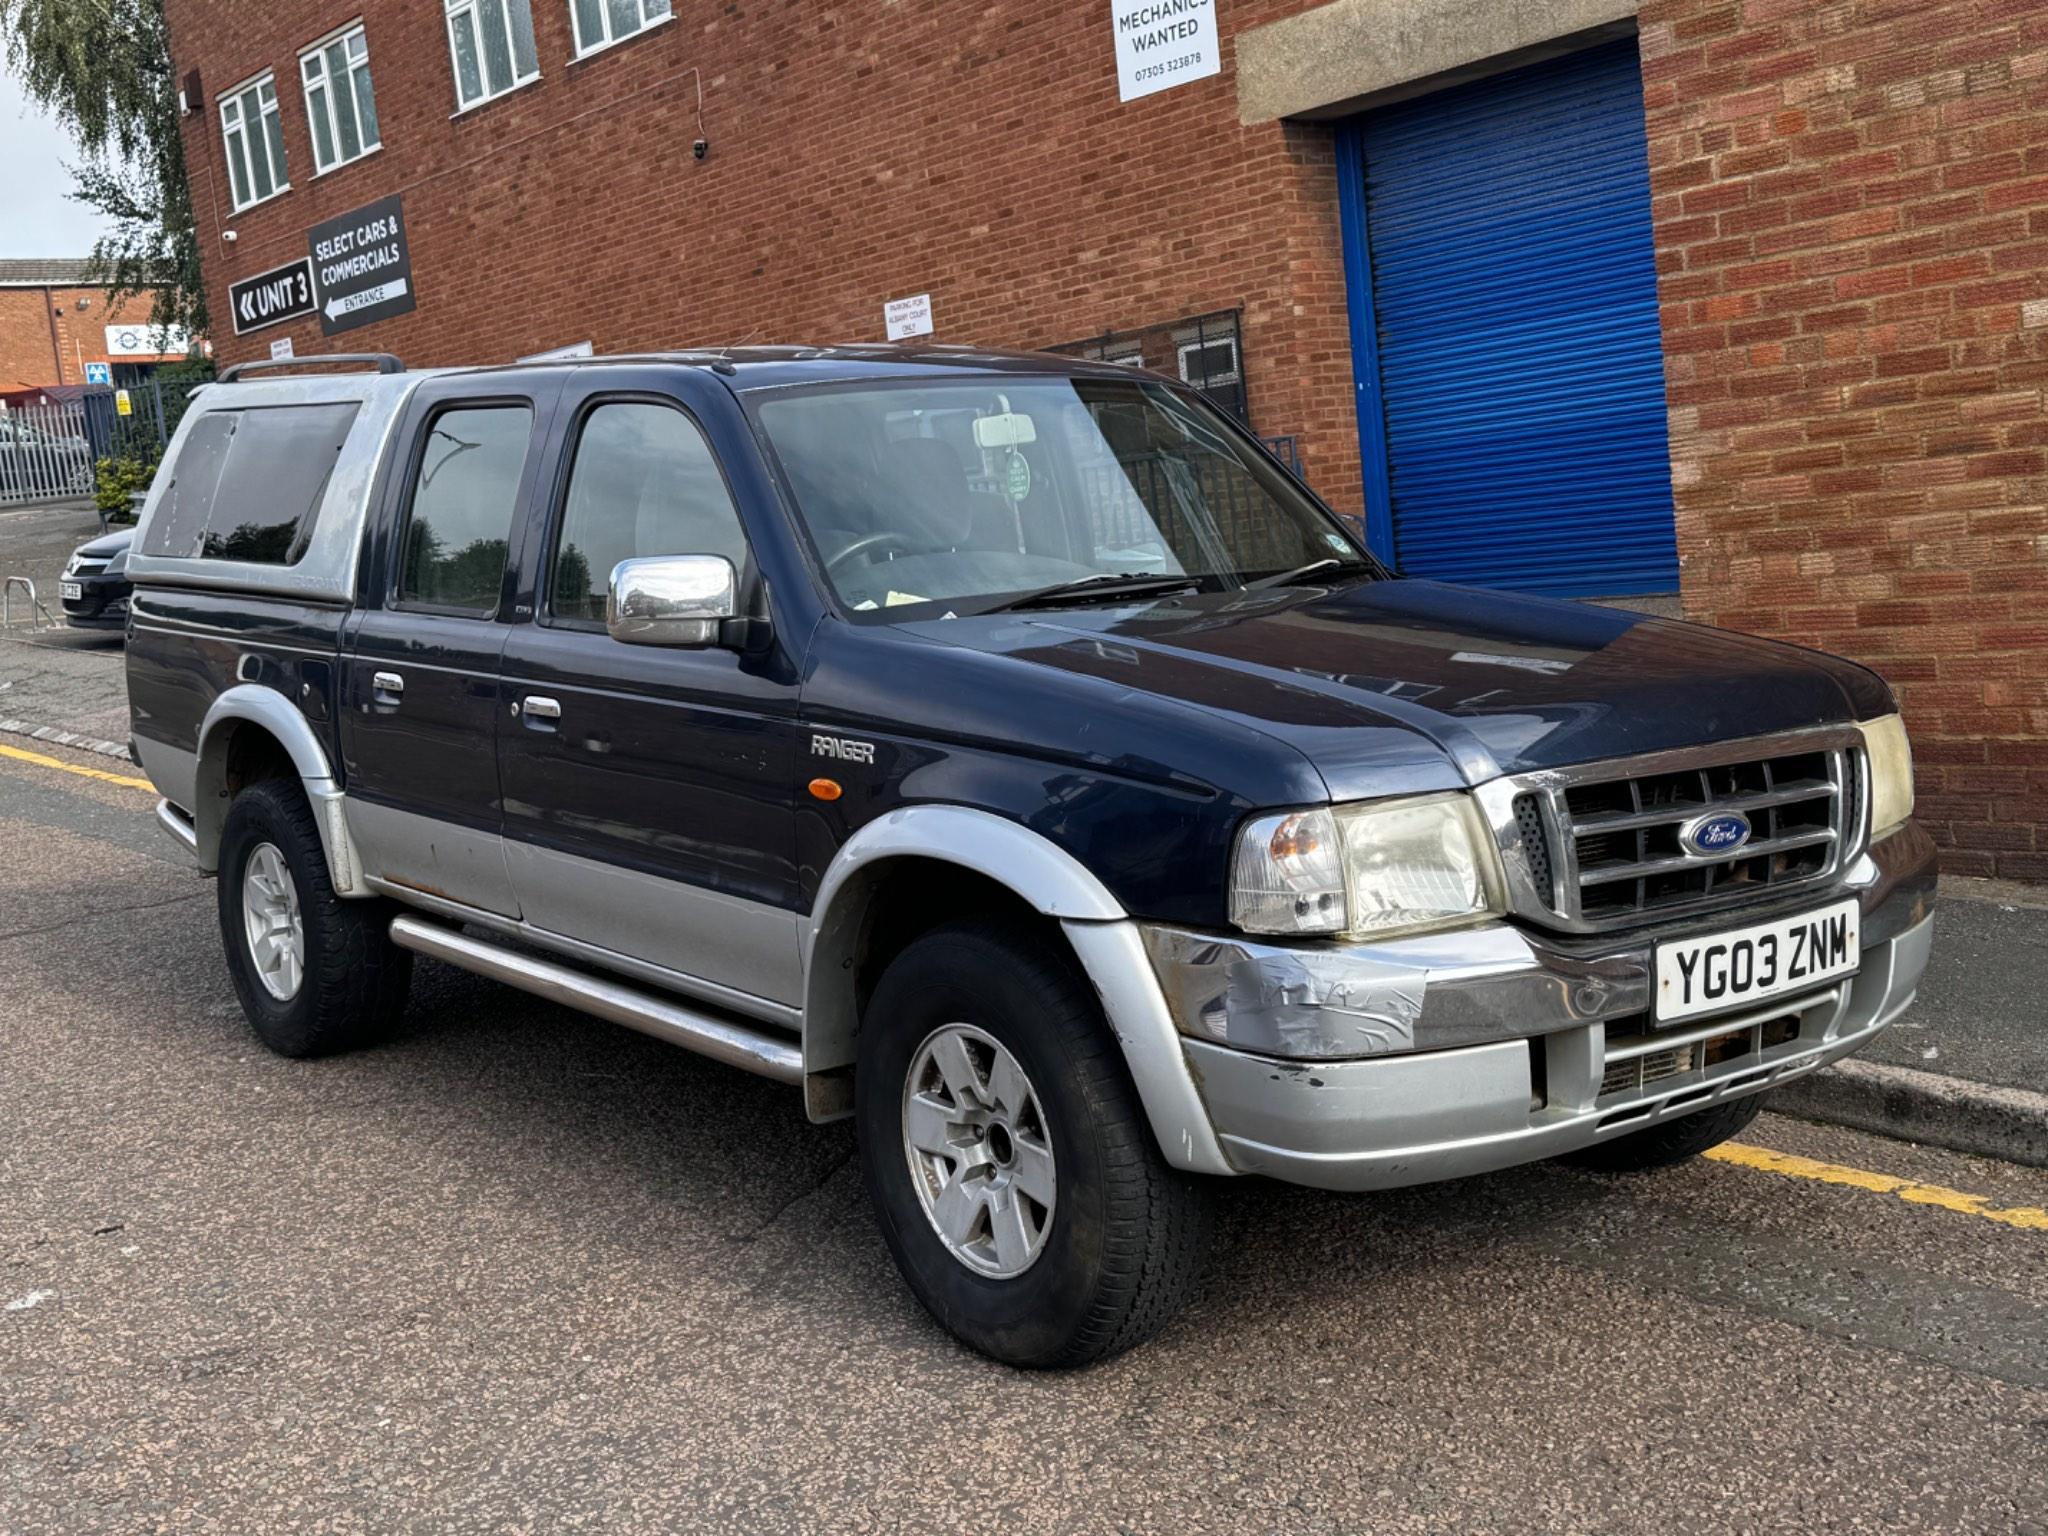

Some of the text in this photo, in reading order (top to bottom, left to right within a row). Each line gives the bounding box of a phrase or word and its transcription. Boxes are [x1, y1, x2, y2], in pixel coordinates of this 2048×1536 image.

[1132, 18, 1199, 53] WANTED
[1135, 52, 1202, 82] 07305 323878
[315, 215, 398, 262] SELECT CARS &
[321, 243, 400, 287] COMMERCIALS
[256, 271, 308, 318] UNIT 3
[344, 287, 385, 311] ENTRANCE
[811, 734, 875, 765] RANGER
[1703, 824, 1737, 845] Ford
[1676, 912, 1847, 1004] YG03 ZNM
